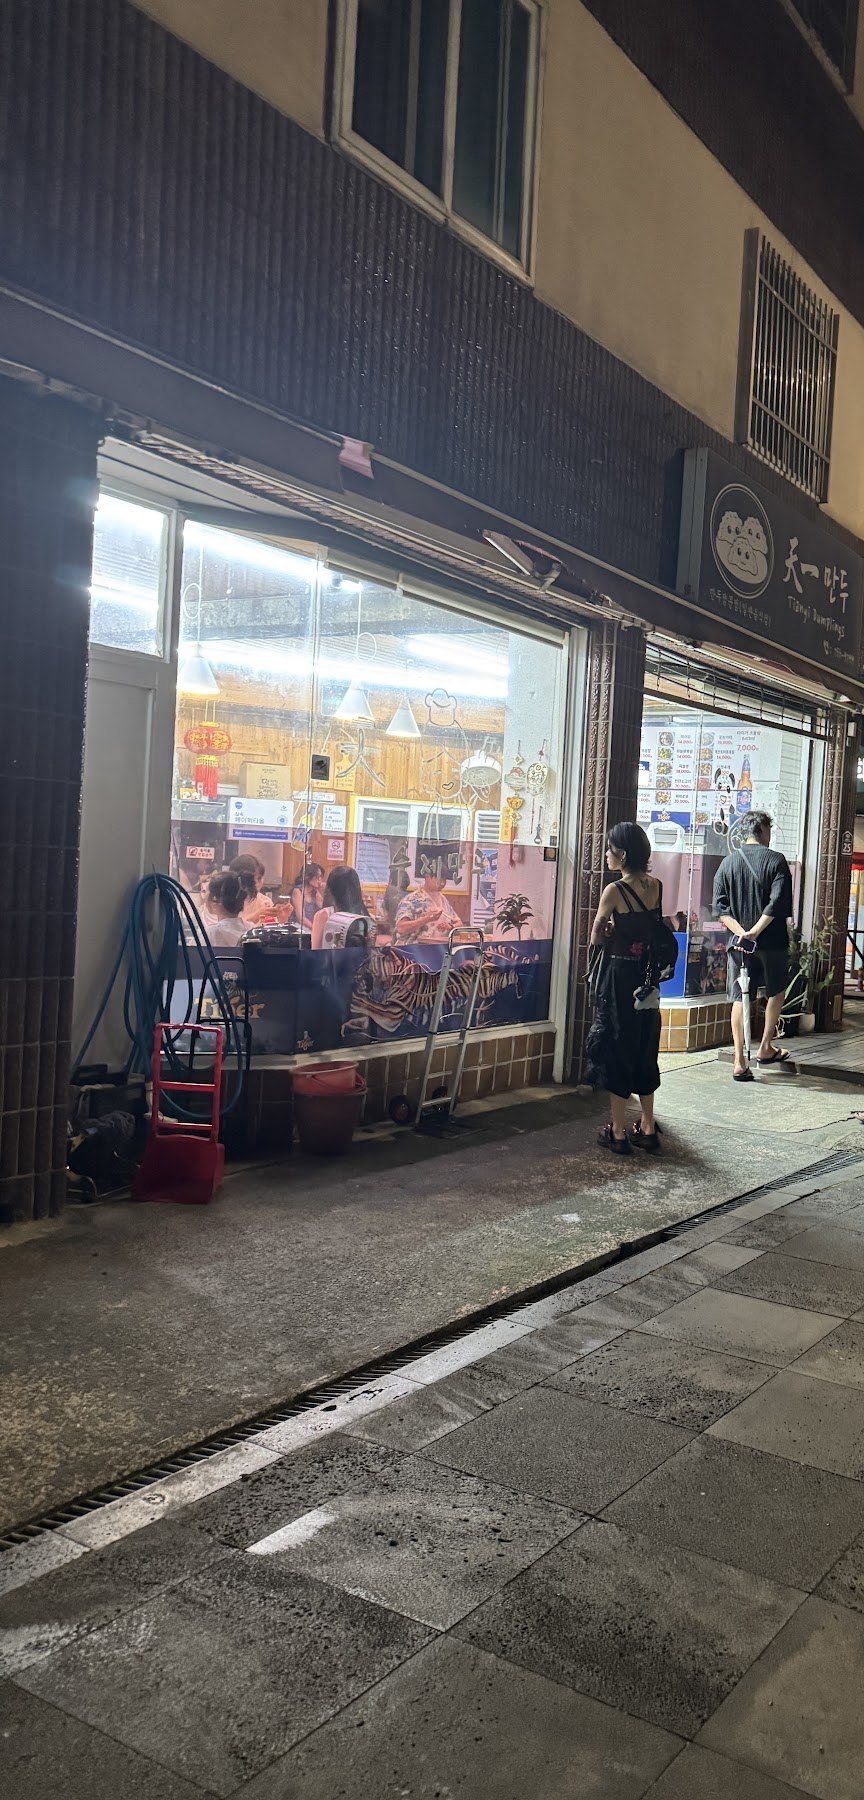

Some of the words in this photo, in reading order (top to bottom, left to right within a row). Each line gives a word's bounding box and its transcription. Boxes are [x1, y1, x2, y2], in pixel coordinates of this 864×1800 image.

[787, 595, 811, 624] Tianyi
[812, 608, 845, 641] Dumplings
[843, 842, 851, 852] 25
[388, 845, 487, 900] 수제만두
[193, 997, 265, 1019] Tier
[296, 1040, 314, 1051] Tiger
